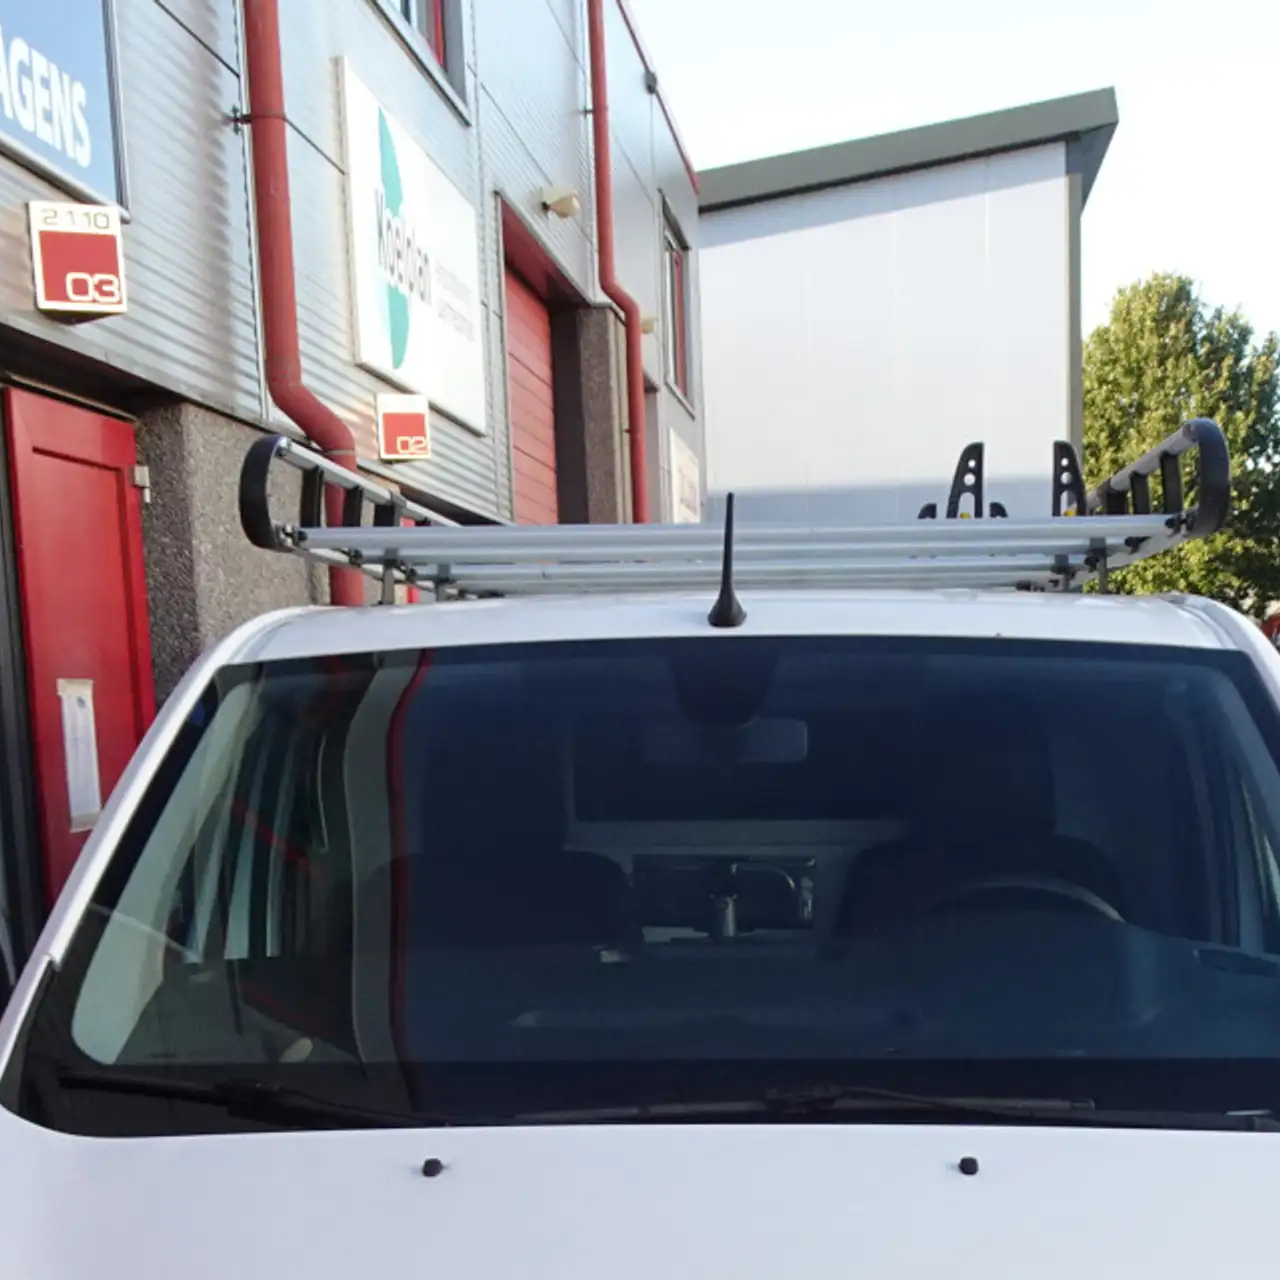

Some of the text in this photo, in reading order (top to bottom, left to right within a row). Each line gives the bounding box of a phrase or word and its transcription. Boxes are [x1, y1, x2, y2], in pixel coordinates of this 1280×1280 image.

[41, 208, 110, 230] 2110
[65, 272, 120, 303] 03
[396, 435, 429, 454] 02
